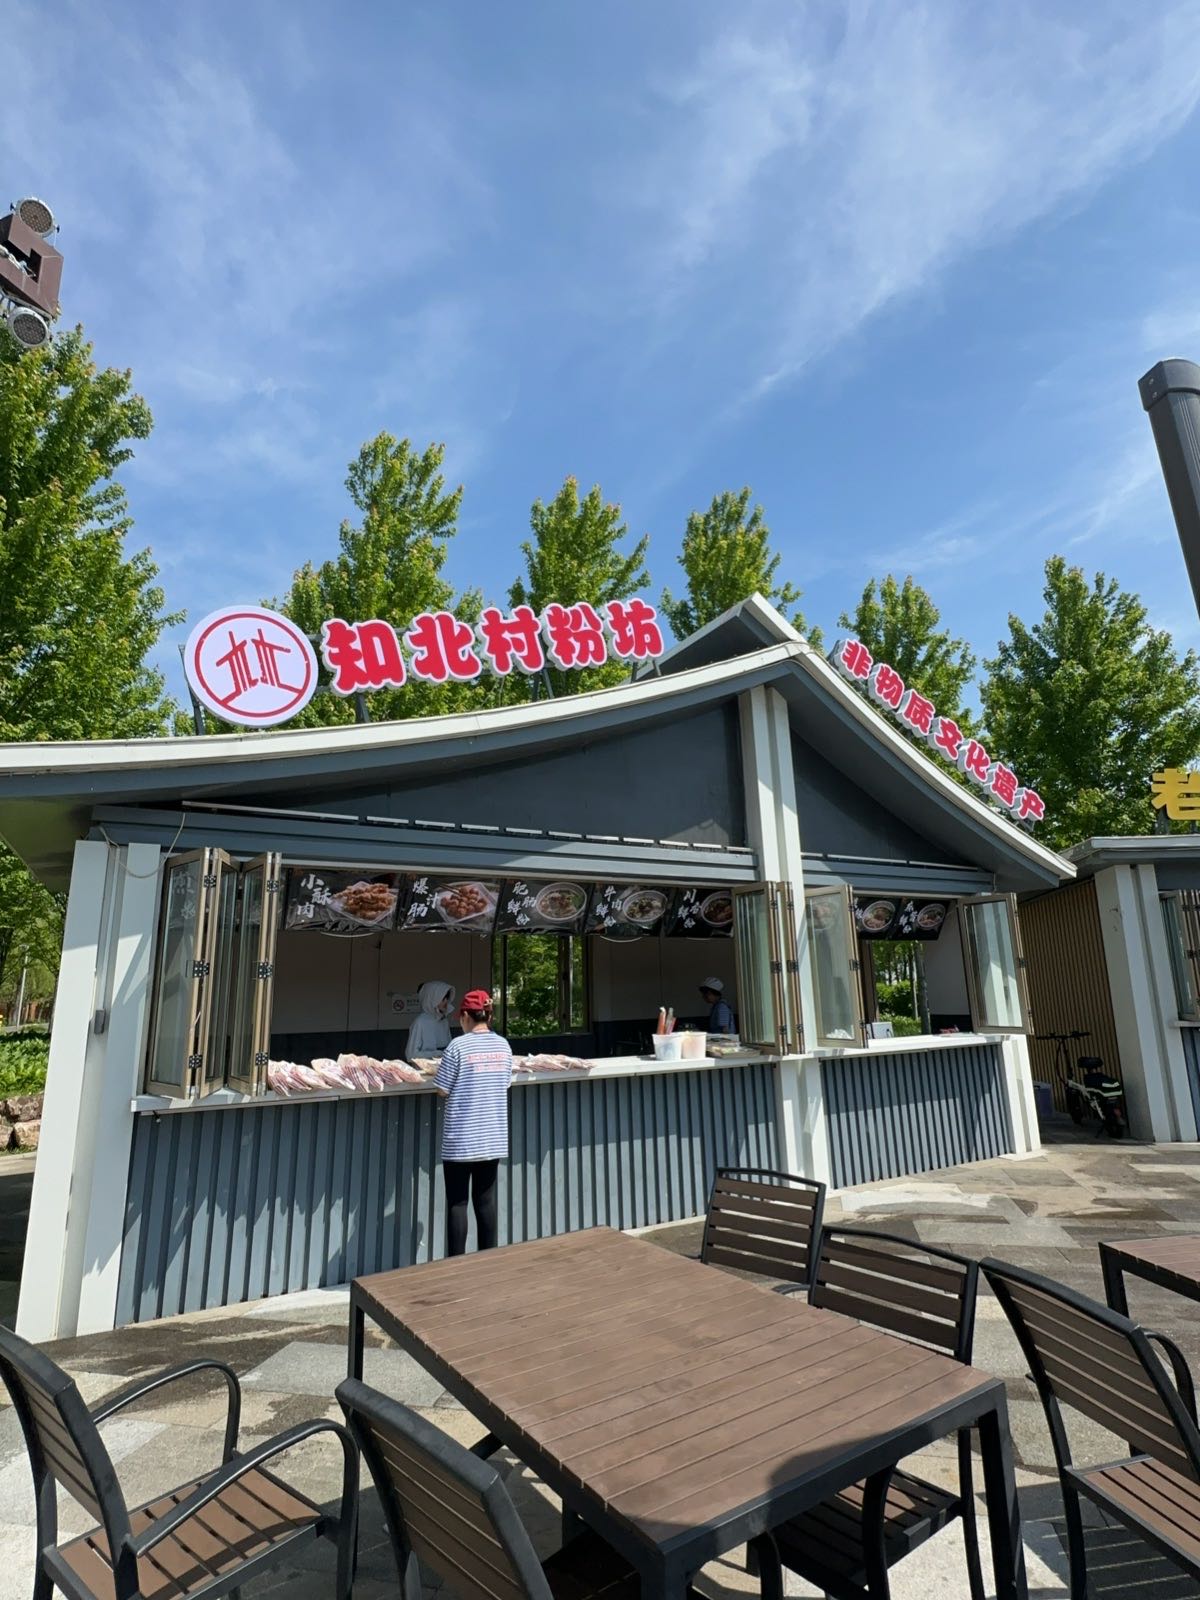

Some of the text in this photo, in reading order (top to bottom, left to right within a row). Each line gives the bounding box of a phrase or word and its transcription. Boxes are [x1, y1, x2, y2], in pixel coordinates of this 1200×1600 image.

[323, 599, 666, 693] 知北村粉坊
[836, 638, 1046, 822] 非物质文化遗产
[297, 873, 333, 919] 小酥肉
[407, 877, 441, 918] 爆汁肠
